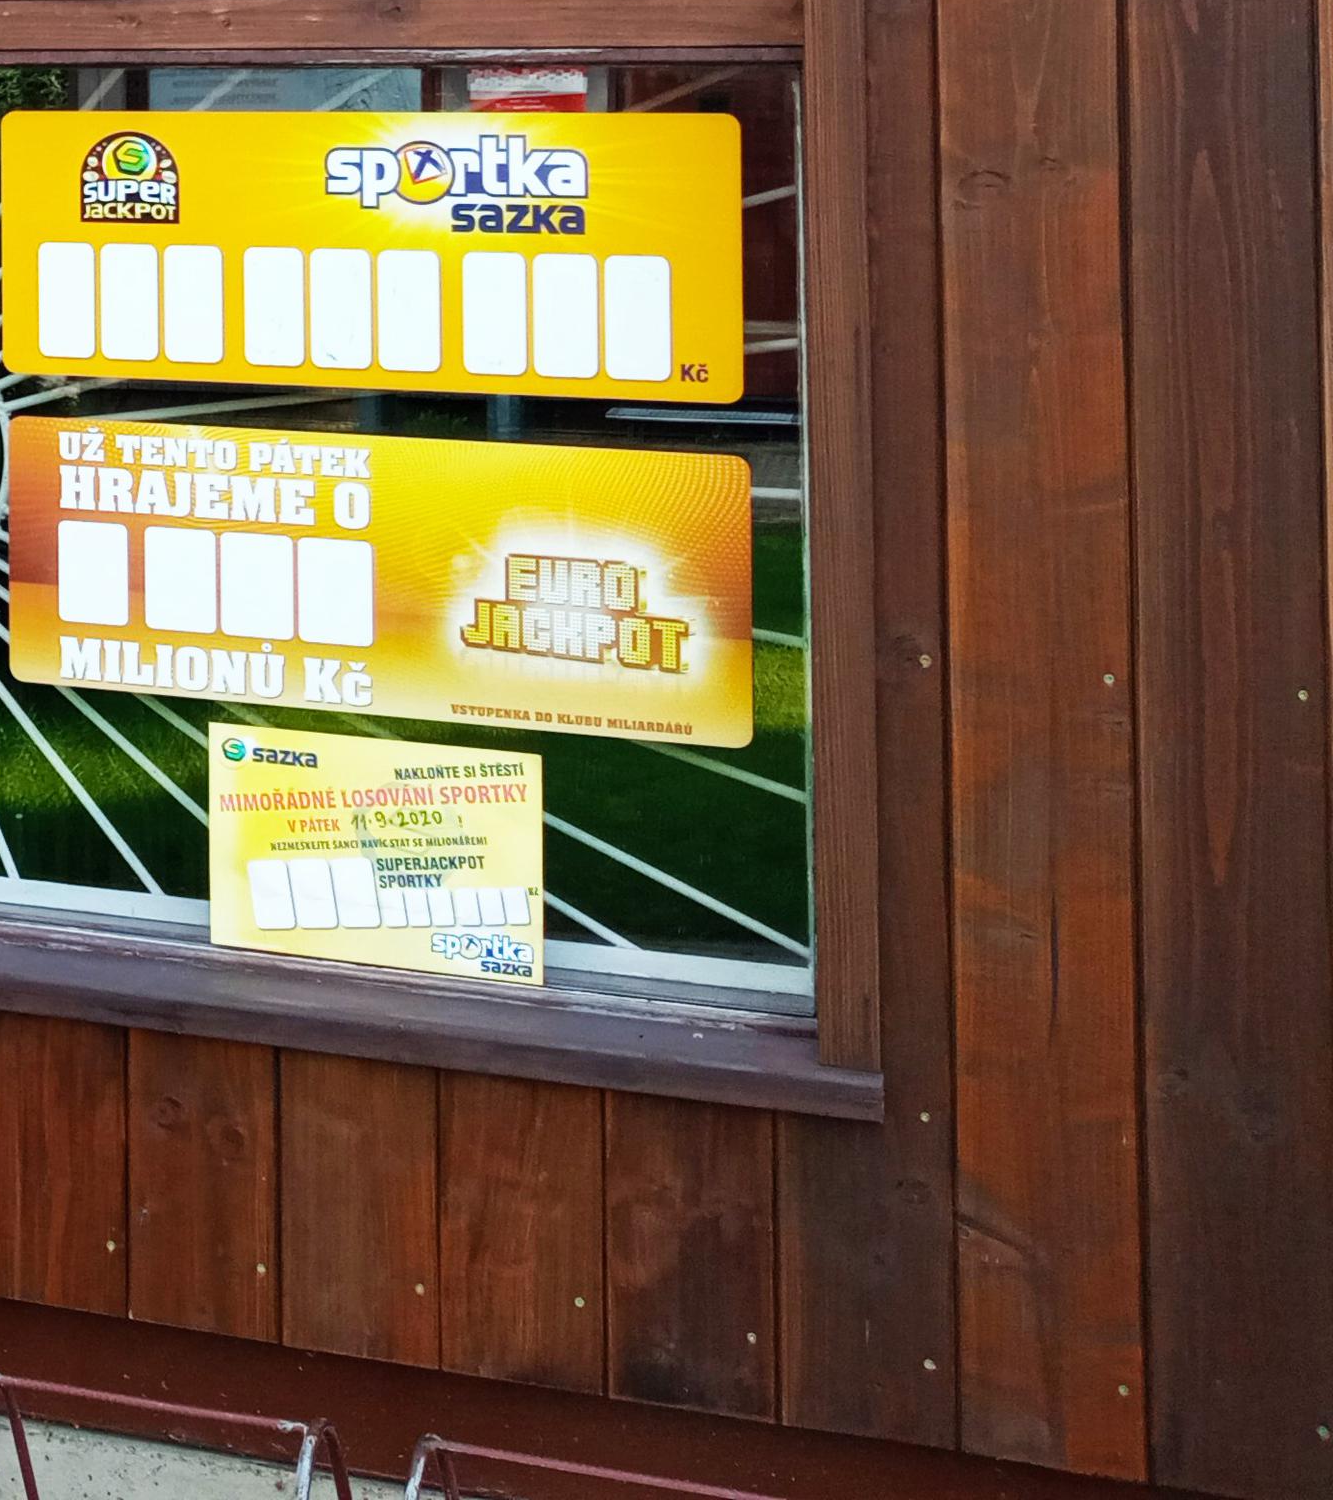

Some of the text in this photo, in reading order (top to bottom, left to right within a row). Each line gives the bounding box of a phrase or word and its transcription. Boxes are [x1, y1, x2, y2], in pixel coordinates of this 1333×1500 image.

[325, 134, 589, 210] sportka
[680, 362, 710, 385] Kč
[58, 426, 373, 479] UŽ TENTO PÁTEK
[58, 464, 372, 531] HRAJEME O
[506, 553, 639, 612] EURO
[461, 599, 689, 674] JACKPOT
[59, 635, 374, 708] MILIONŮ Kč
[450, 703, 531, 722] VSTUPENKA
[535, 711, 553, 724] DO
[557, 713, 602, 728] KLUBU
[393, 762, 525, 781] NAKLOŇTE SI ŠTĚSTÍ
[219, 782, 528, 813] MIMOŘÁDNÉ LOSOVÁNÍ SPORTKY
[288, 820, 297, 834] V
[360, 836, 389, 849] NAVÍC
[413, 837, 423, 847] SE
[376, 855, 486, 872] SUPERJACKPOT
[378, 873, 443, 889] SPORTKY
